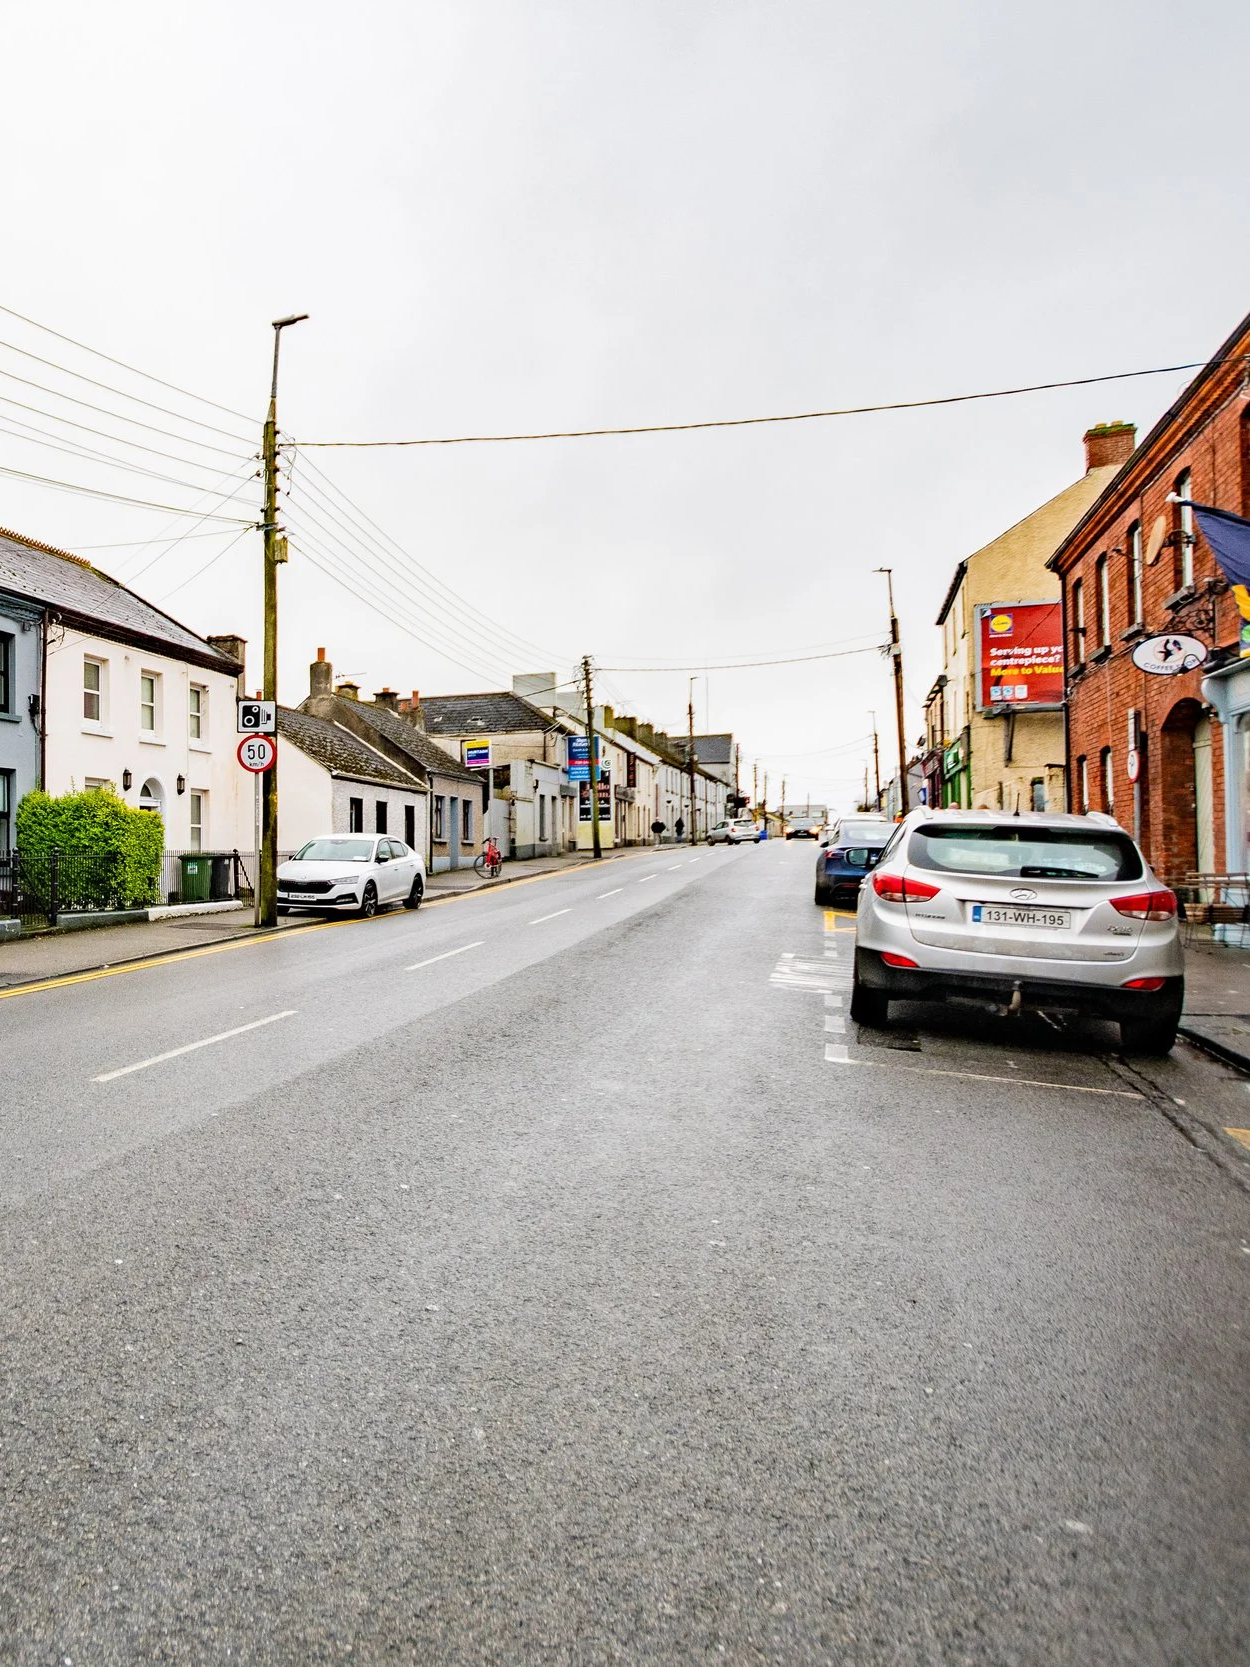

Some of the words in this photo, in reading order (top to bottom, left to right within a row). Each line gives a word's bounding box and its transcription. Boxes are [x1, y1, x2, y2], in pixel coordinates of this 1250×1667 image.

[990, 646, 1032, 656] Serving
[1033, 646, 1049, 656] up
[990, 654, 1061, 666] centrepiece?
[990, 668, 1019, 676] More
[1143, 662, 1174, 671] COFFEE
[247, 743, 266, 760] 50
[986, 910, 1065, 927] 131-WH-195
